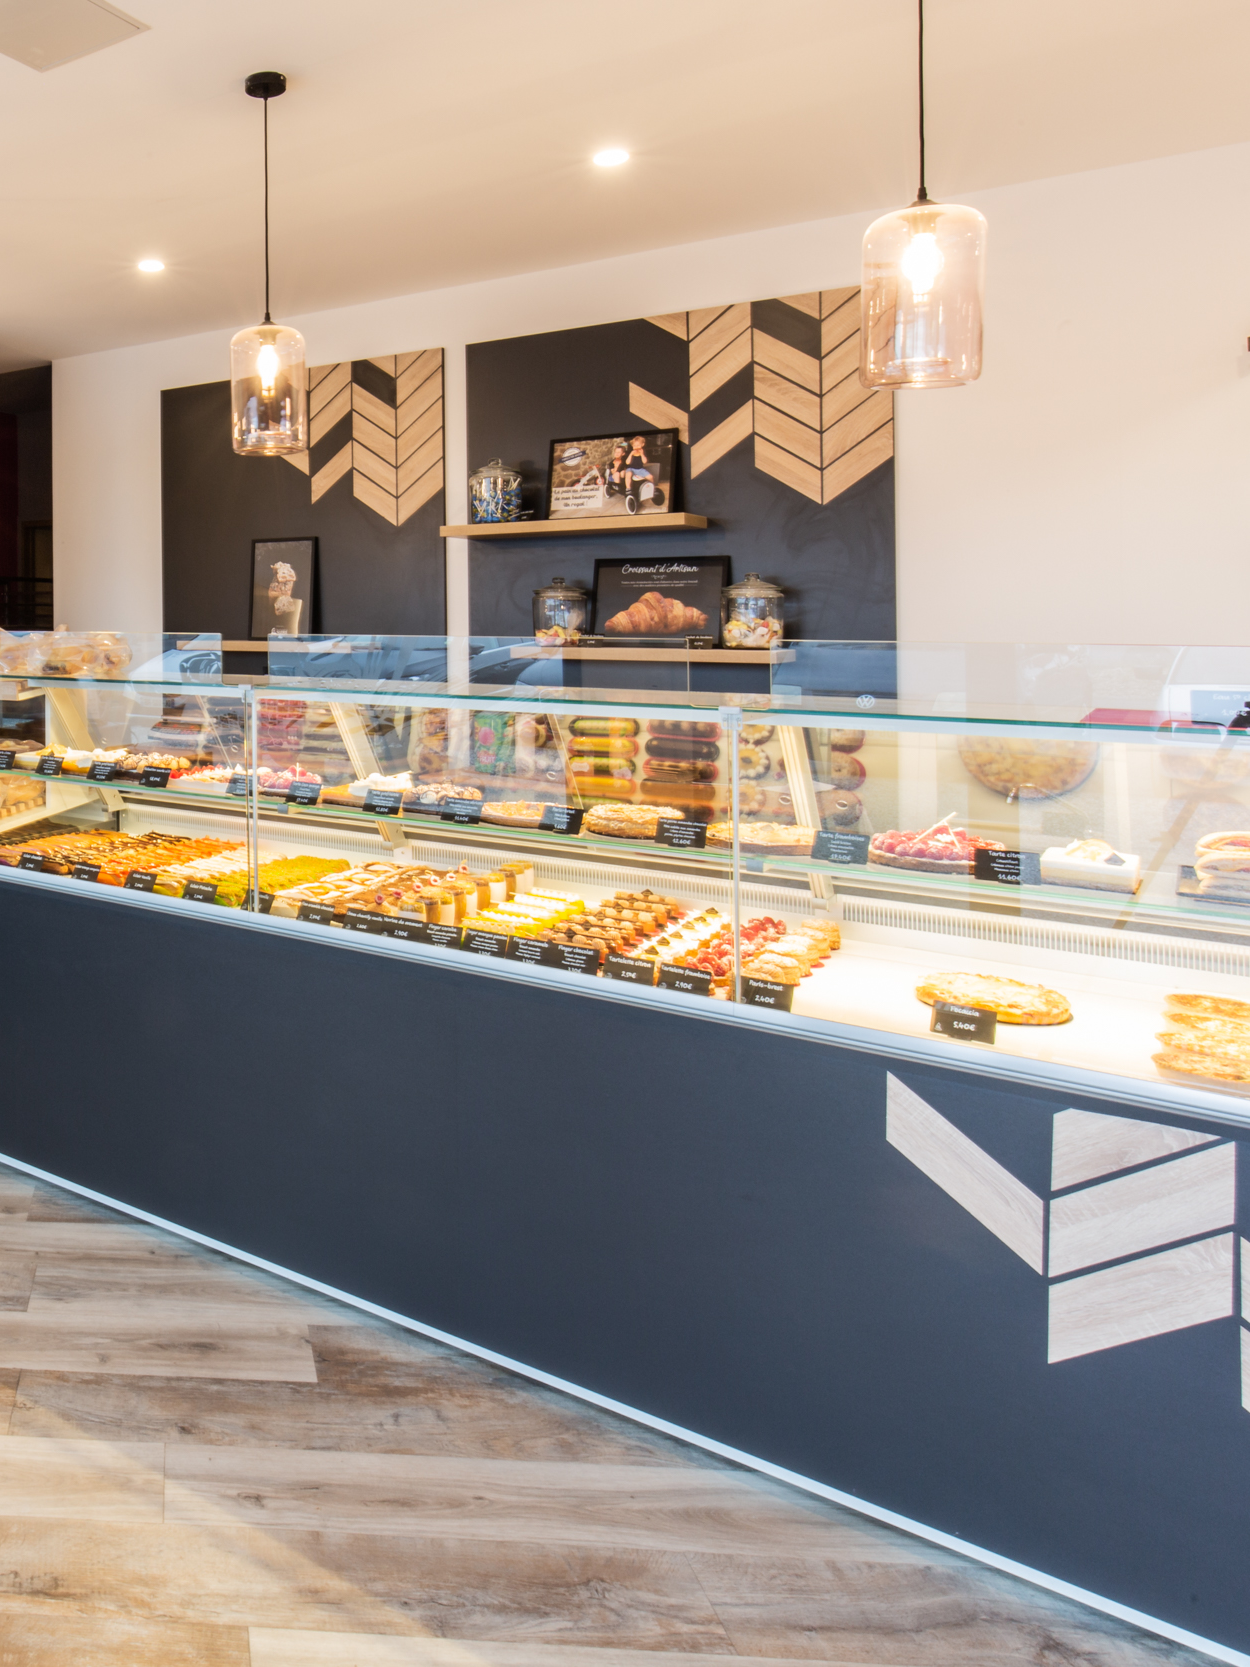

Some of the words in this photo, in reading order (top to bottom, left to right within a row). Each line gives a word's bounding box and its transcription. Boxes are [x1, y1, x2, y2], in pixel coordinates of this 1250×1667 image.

[621, 563, 659, 574] Croissant
[988, 850, 1006, 858] Tarte
[997, 873, 1022, 881] 11,60€
[428, 923, 442, 931] Finger
[513, 936, 528, 945] Finger
[558, 944, 574, 953] Finger
[573, 947, 594, 956] chocolat
[609, 956, 635, 966] Tartelette
[661, 965, 685, 975] Tartelette
[684, 969, 711, 980] framboise
[675, 981, 693, 990] 2,90€
[748, 980, 784, 992] Paris-brest
[754, 995, 775, 1005] 2,40€
[949, 1005, 980, 1017] Focaccia
[953, 1021, 976, 1032] 5,40€
